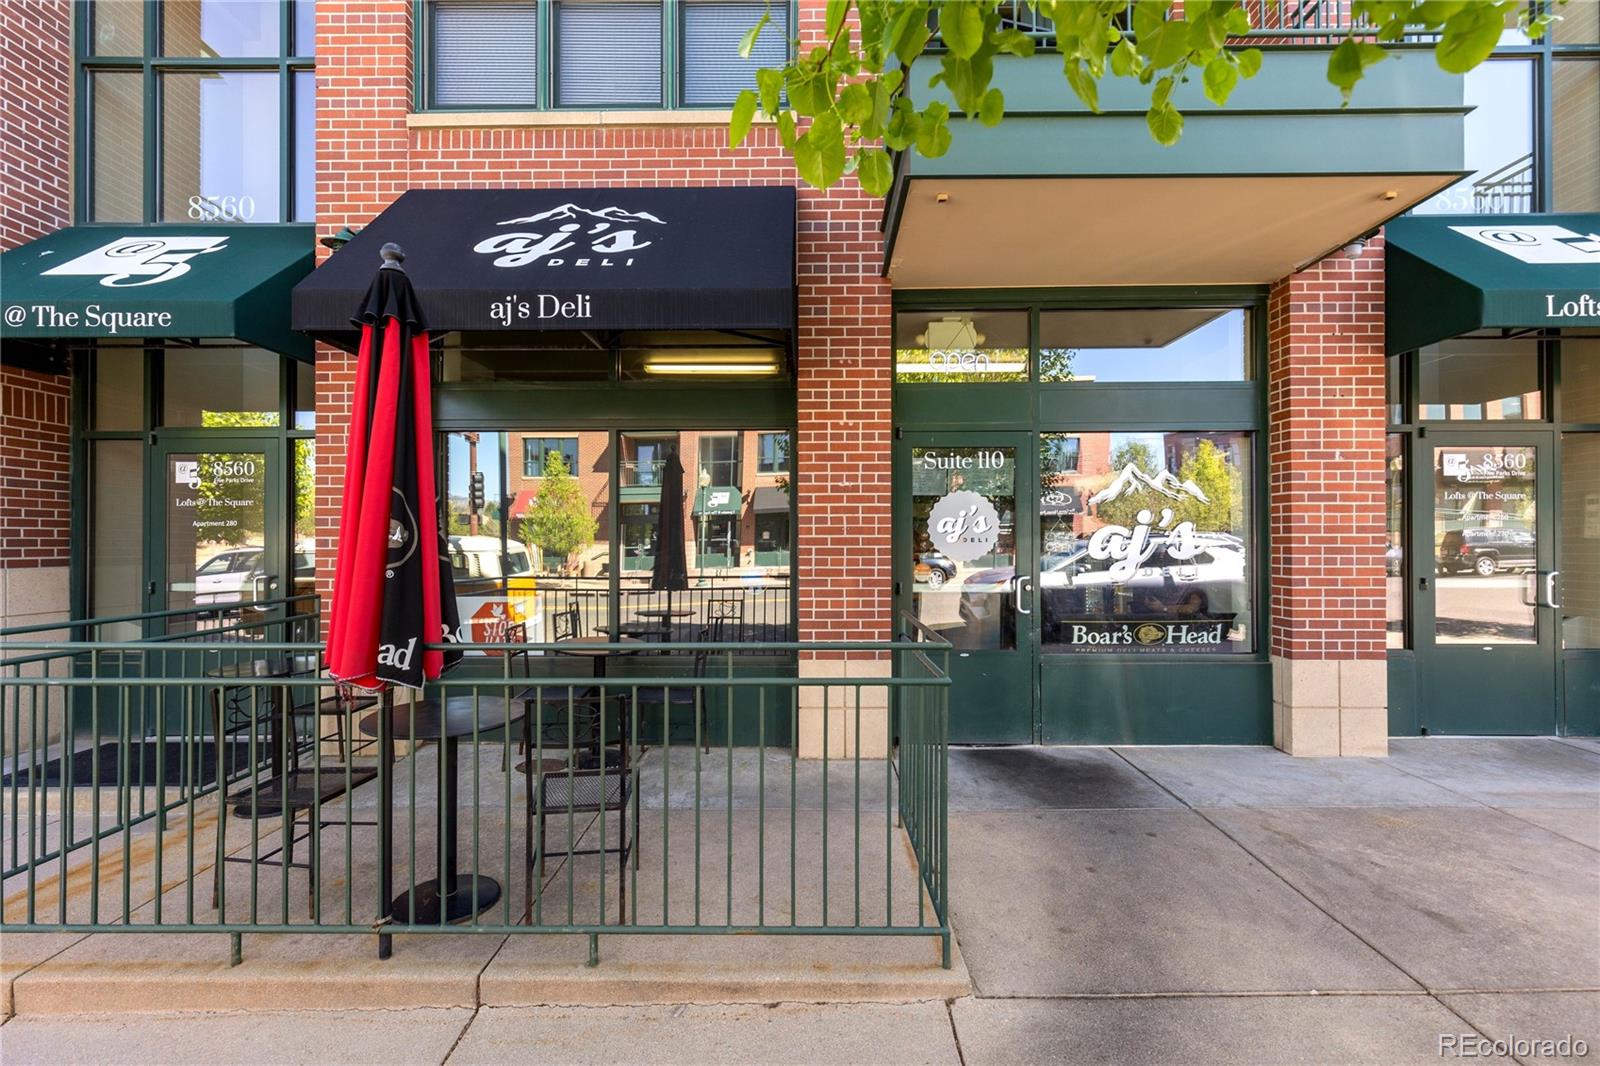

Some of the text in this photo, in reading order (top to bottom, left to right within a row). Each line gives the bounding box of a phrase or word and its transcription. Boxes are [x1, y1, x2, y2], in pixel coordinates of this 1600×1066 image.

[187, 195, 255, 220] 8560
[473, 222, 652, 268] aj's
[547, 258, 634, 267] DELI
[4, 304, 172, 334] @ The Square
[489, 294, 592, 327] aj's Deli
[213, 461, 255, 477] 8560
[923, 450, 1005, 470] Suite 110
[1483, 453, 1527, 469] 8560
[176, 498, 196, 507] Lofts
[207, 498, 223, 506] The
[224, 498, 254, 508] Square
[1444, 491, 1465, 500] Lofts
[1477, 491, 1494, 500] The
[1495, 491, 1526, 502] Square
[192, 520, 225, 528] Apartment
[936, 504, 993, 543] aj's
[1088, 508, 1208, 582] aj's
[1071, 624, 1222, 645] Boar's Head
[377, 637, 417, 671] ad
